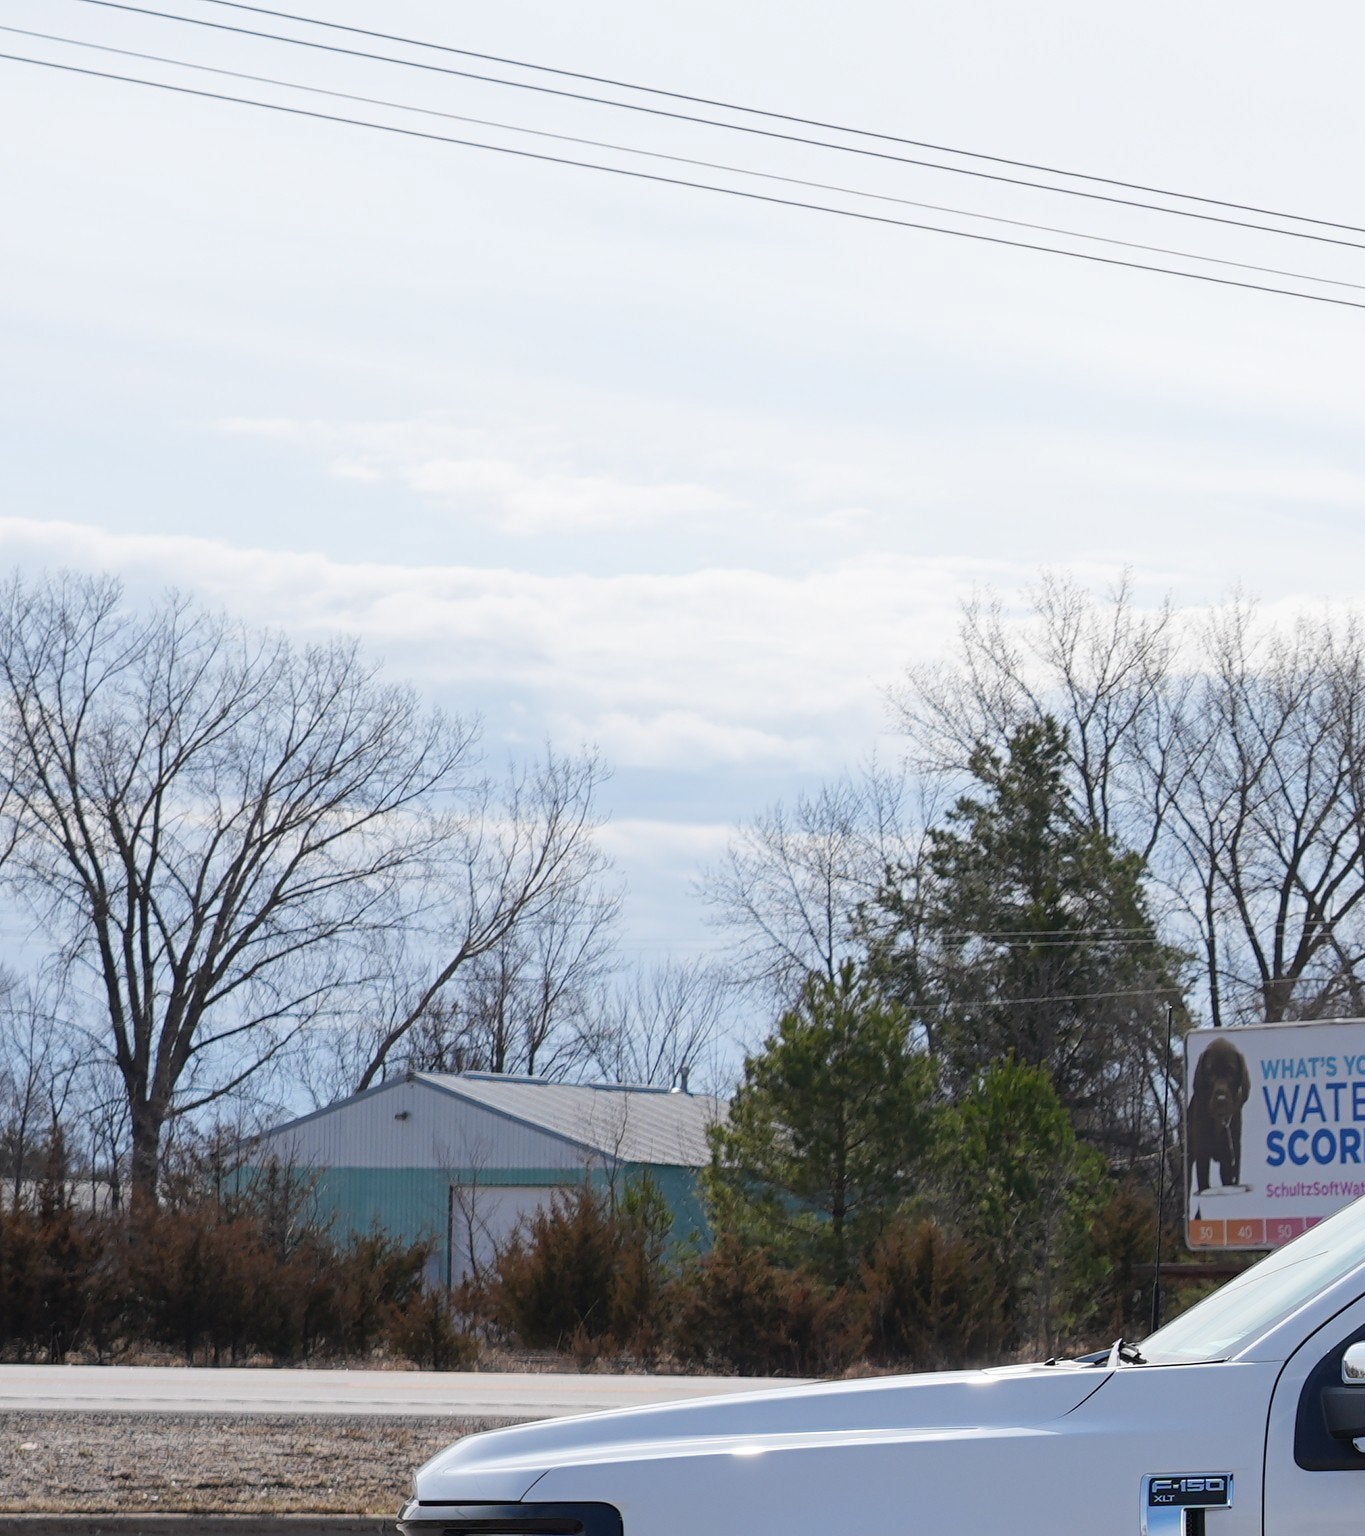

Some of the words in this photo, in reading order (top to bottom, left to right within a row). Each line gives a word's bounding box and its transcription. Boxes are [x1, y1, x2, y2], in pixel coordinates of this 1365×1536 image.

[1260, 1055, 1338, 1080] WHAT'S
[1200, 1226, 1213, 1239] 30
[1237, 1225, 1252, 1238] 40
[1277, 1224, 1292, 1238] 50
[1151, 1478, 1225, 1493] F-150
[1153, 1494, 1176, 1503] XLT
